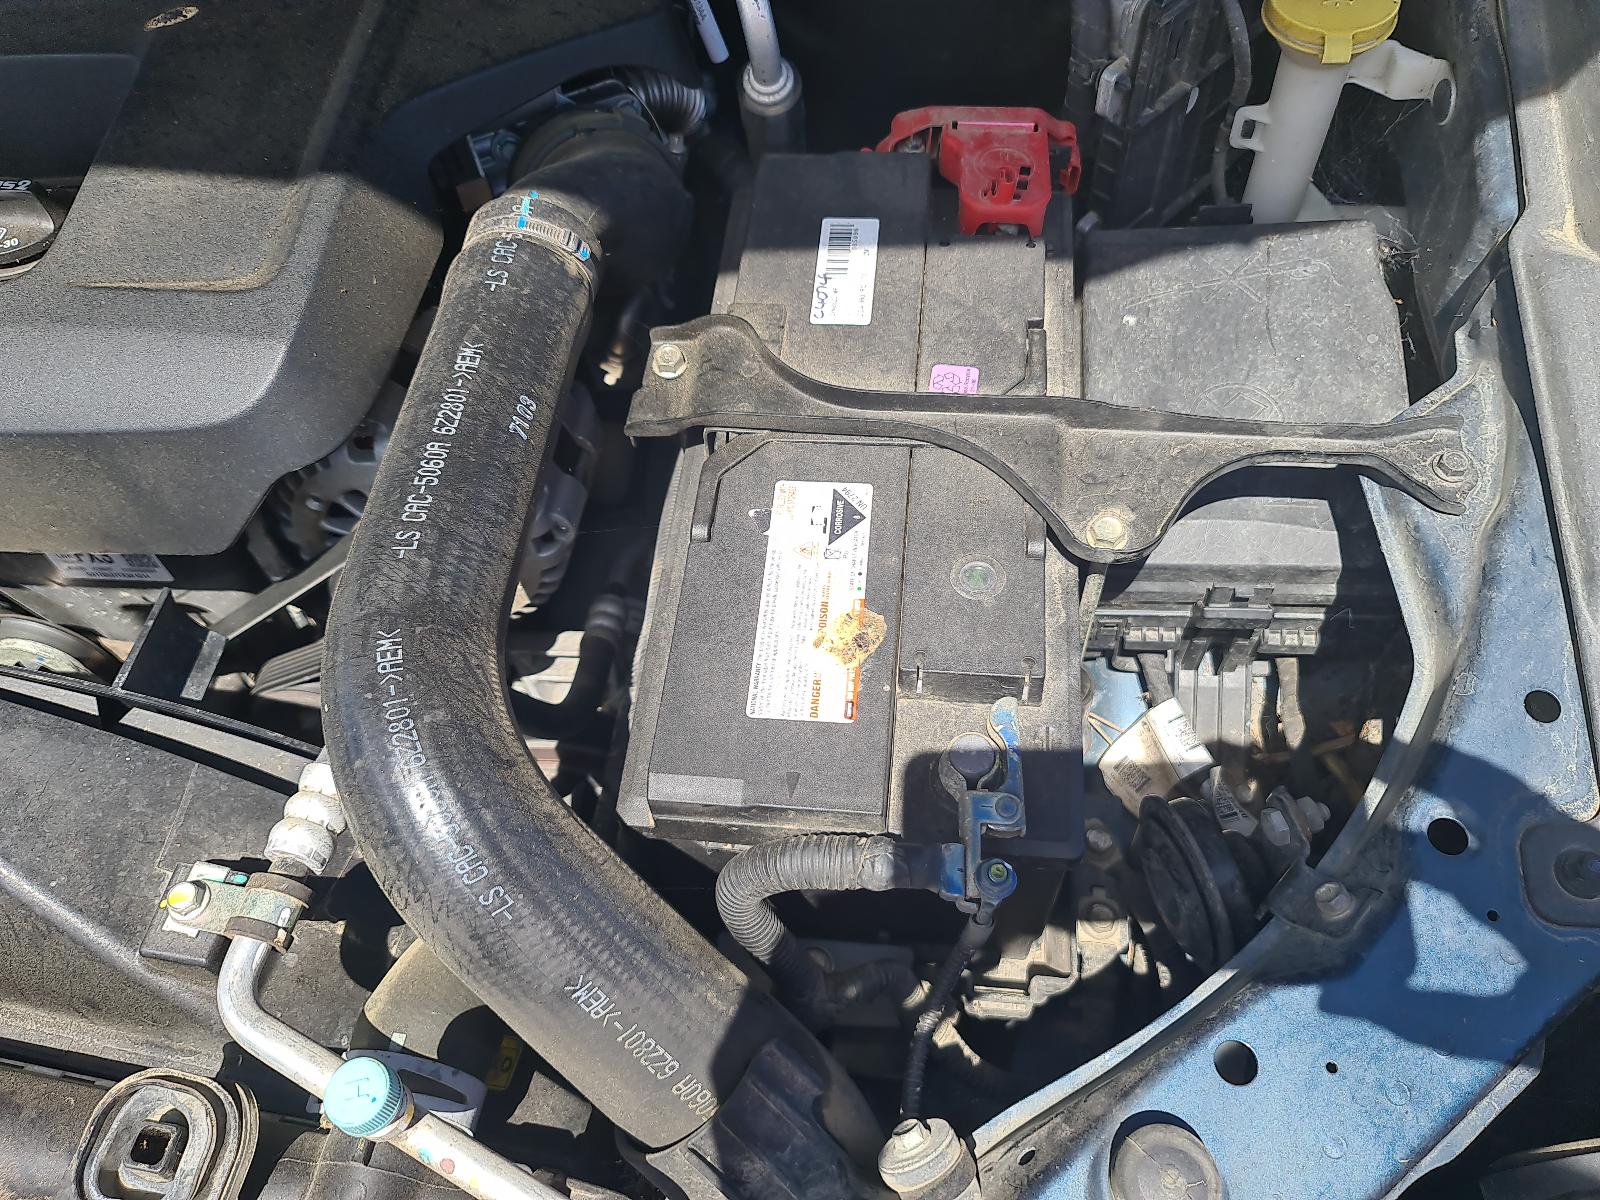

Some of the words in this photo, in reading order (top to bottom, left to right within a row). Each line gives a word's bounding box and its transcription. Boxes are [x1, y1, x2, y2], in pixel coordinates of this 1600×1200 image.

[508, 394, 538, 441] 7103
[402, 441, 452, 522] CAC-5060A
[841, 486, 859, 502] 2794
[833, 499, 845, 535] CORROSIVE
[809, 679, 822, 719] DANGER
